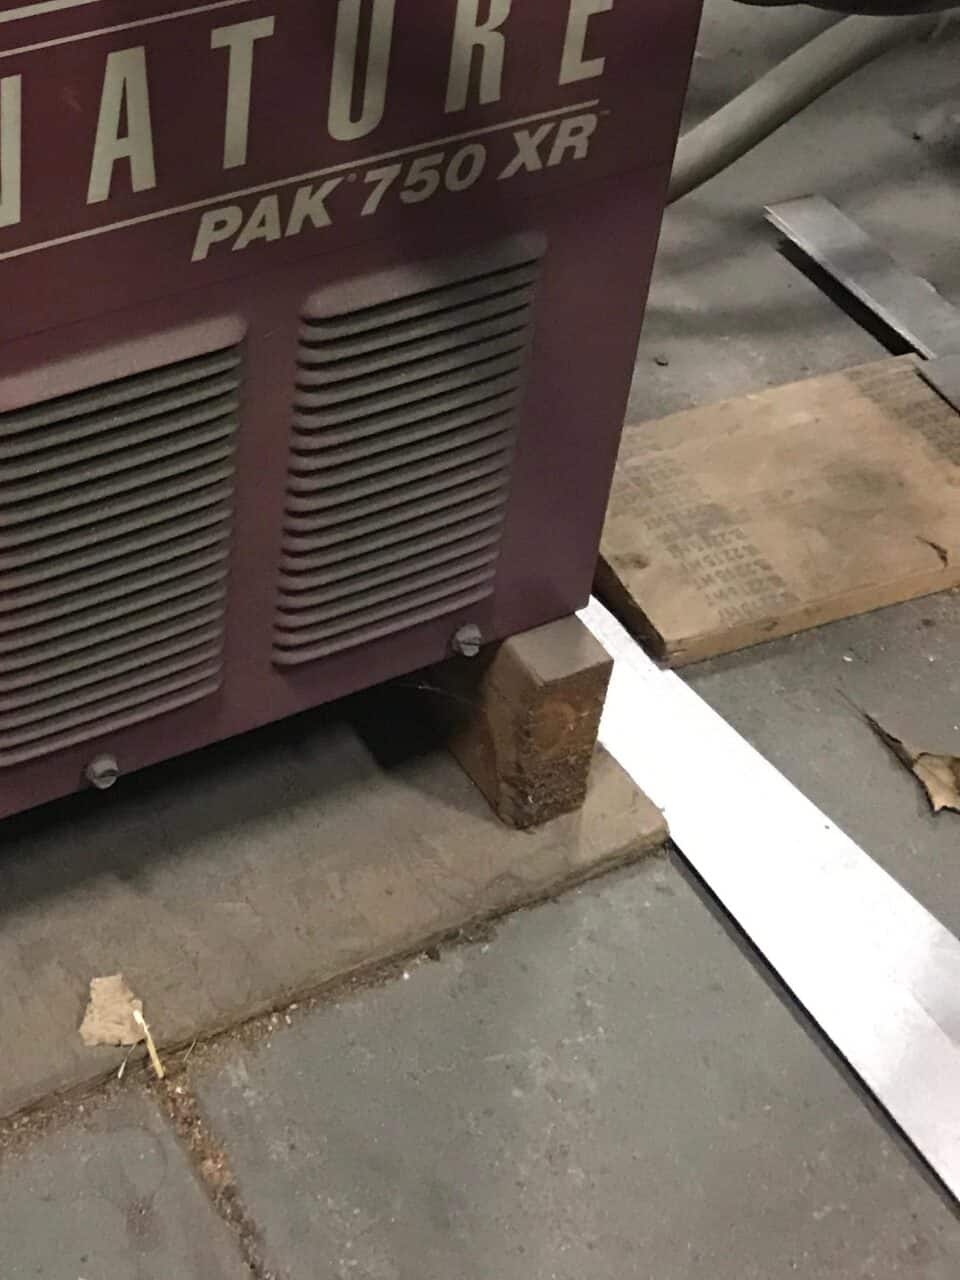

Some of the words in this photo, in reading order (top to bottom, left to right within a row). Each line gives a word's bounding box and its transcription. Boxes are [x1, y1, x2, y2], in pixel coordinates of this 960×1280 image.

[190, 176, 345, 264] PAK
[360, 142, 488, 218] 750
[497, 112, 599, 181] XR
